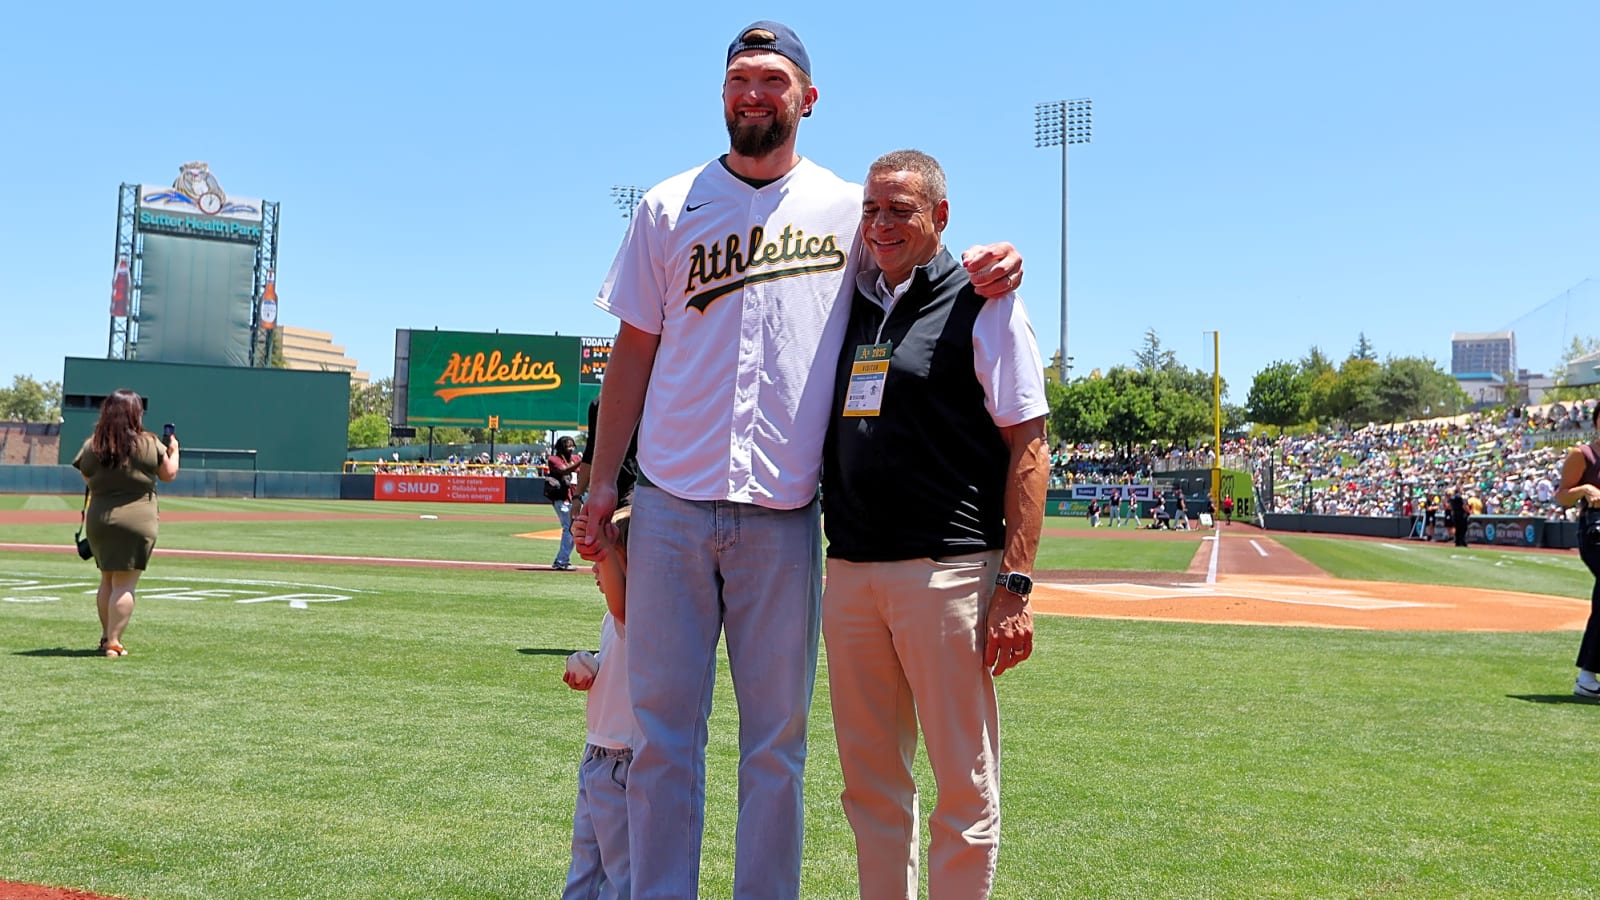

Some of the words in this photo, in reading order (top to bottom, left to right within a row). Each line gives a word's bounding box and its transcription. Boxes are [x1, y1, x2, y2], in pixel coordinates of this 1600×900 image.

[140, 211, 183, 227] Sutter
[185, 216, 228, 233] Health
[230, 221, 261, 236] Park
[684, 223, 840, 296] Athletics
[581, 337, 614, 347] TODAY'S
[435, 349, 557, 387] Athletics
[398, 482, 440, 494] SMUD
